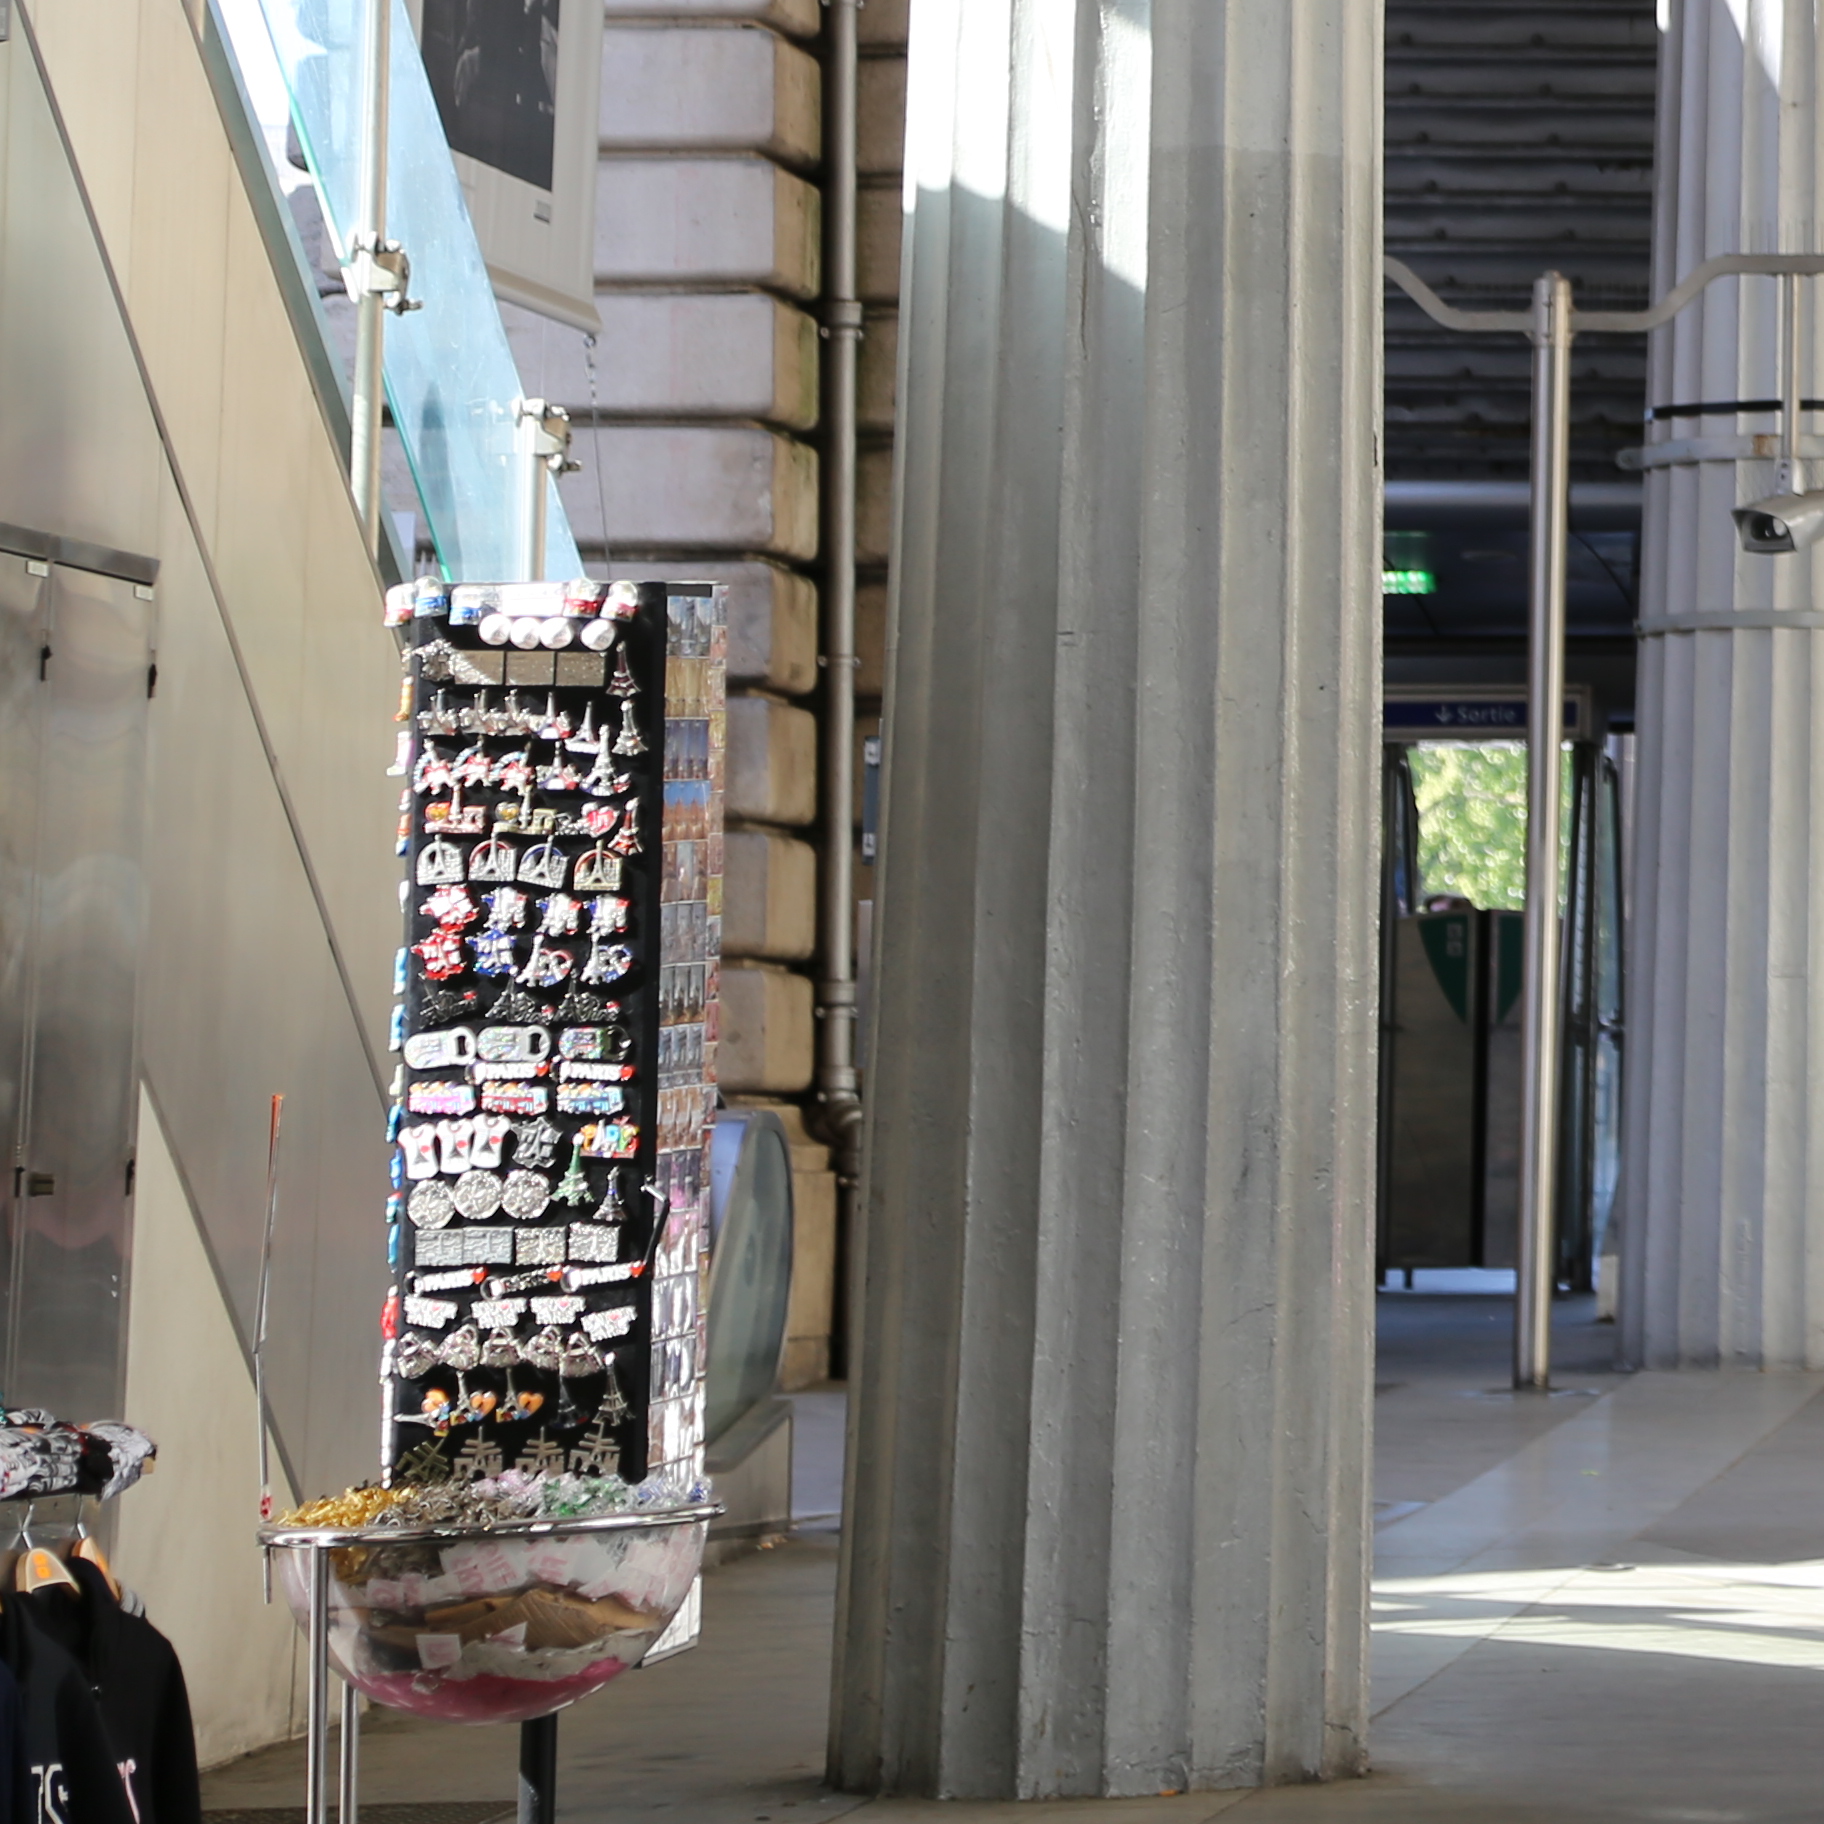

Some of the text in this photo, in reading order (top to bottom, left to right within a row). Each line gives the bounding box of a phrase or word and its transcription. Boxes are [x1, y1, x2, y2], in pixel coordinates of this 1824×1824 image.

[1456, 706, 1517, 724] Sortie
[569, 1063, 623, 1081] PARIS
[423, 1269, 475, 1292] PARIS
[583, 1262, 633, 1289] PARIS
